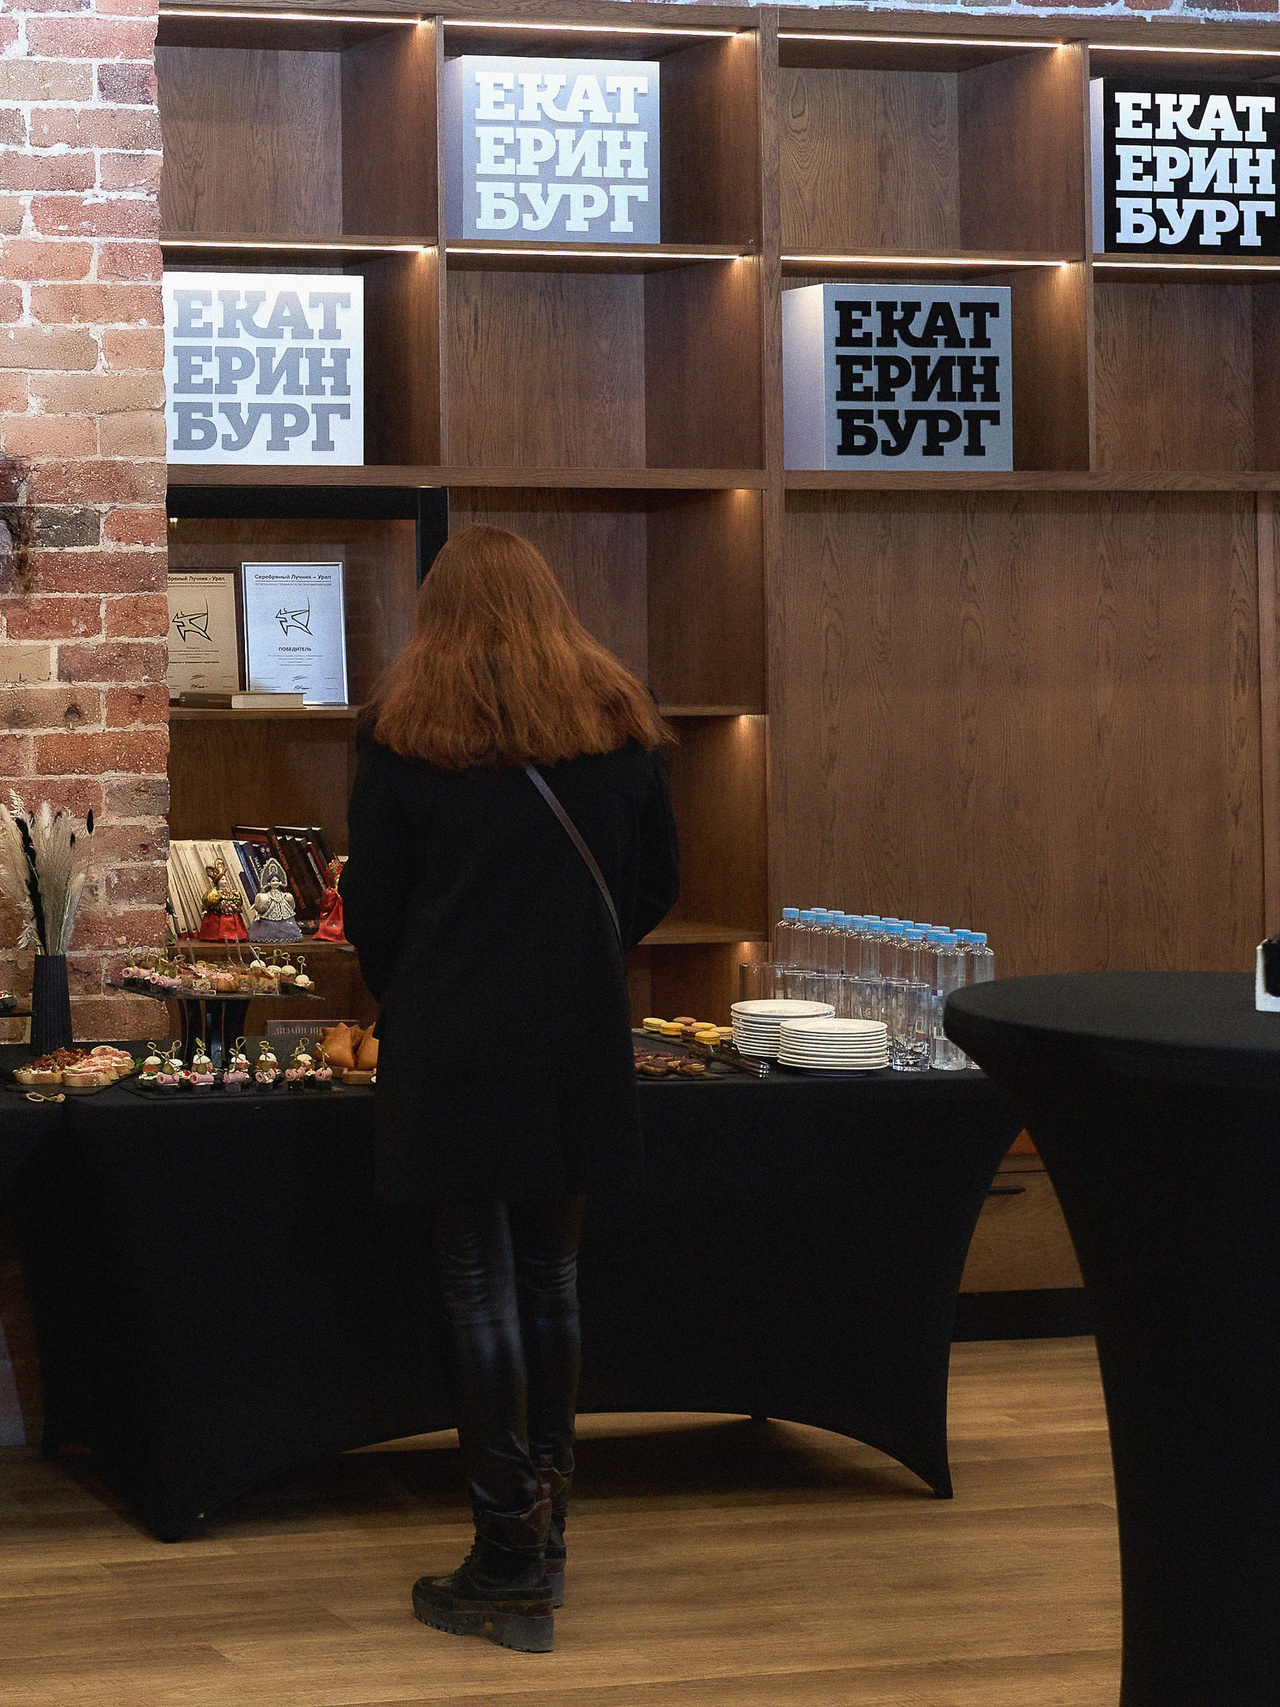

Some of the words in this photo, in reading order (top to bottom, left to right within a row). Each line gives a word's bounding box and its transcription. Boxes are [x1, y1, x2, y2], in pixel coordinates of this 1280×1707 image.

[475, 71, 649, 124] ЕКАТ
[1114, 92, 1276, 142] ЕКАТ
[475, 126, 649, 179] ЕРИН
[1115, 144, 1276, 194] ЕРИН
[475, 181, 649, 232] БУРГ
[1115, 197, 1276, 246] БУРГ
[173, 289, 351, 340] ЕКАТ
[834, 300, 1000, 348] ЕКАТ
[173, 345, 351, 396] ЕРИН
[835, 354, 1000, 403] ЕРИН
[173, 401, 351, 451] БУРГ
[836, 409, 1001, 456] БУРГ
